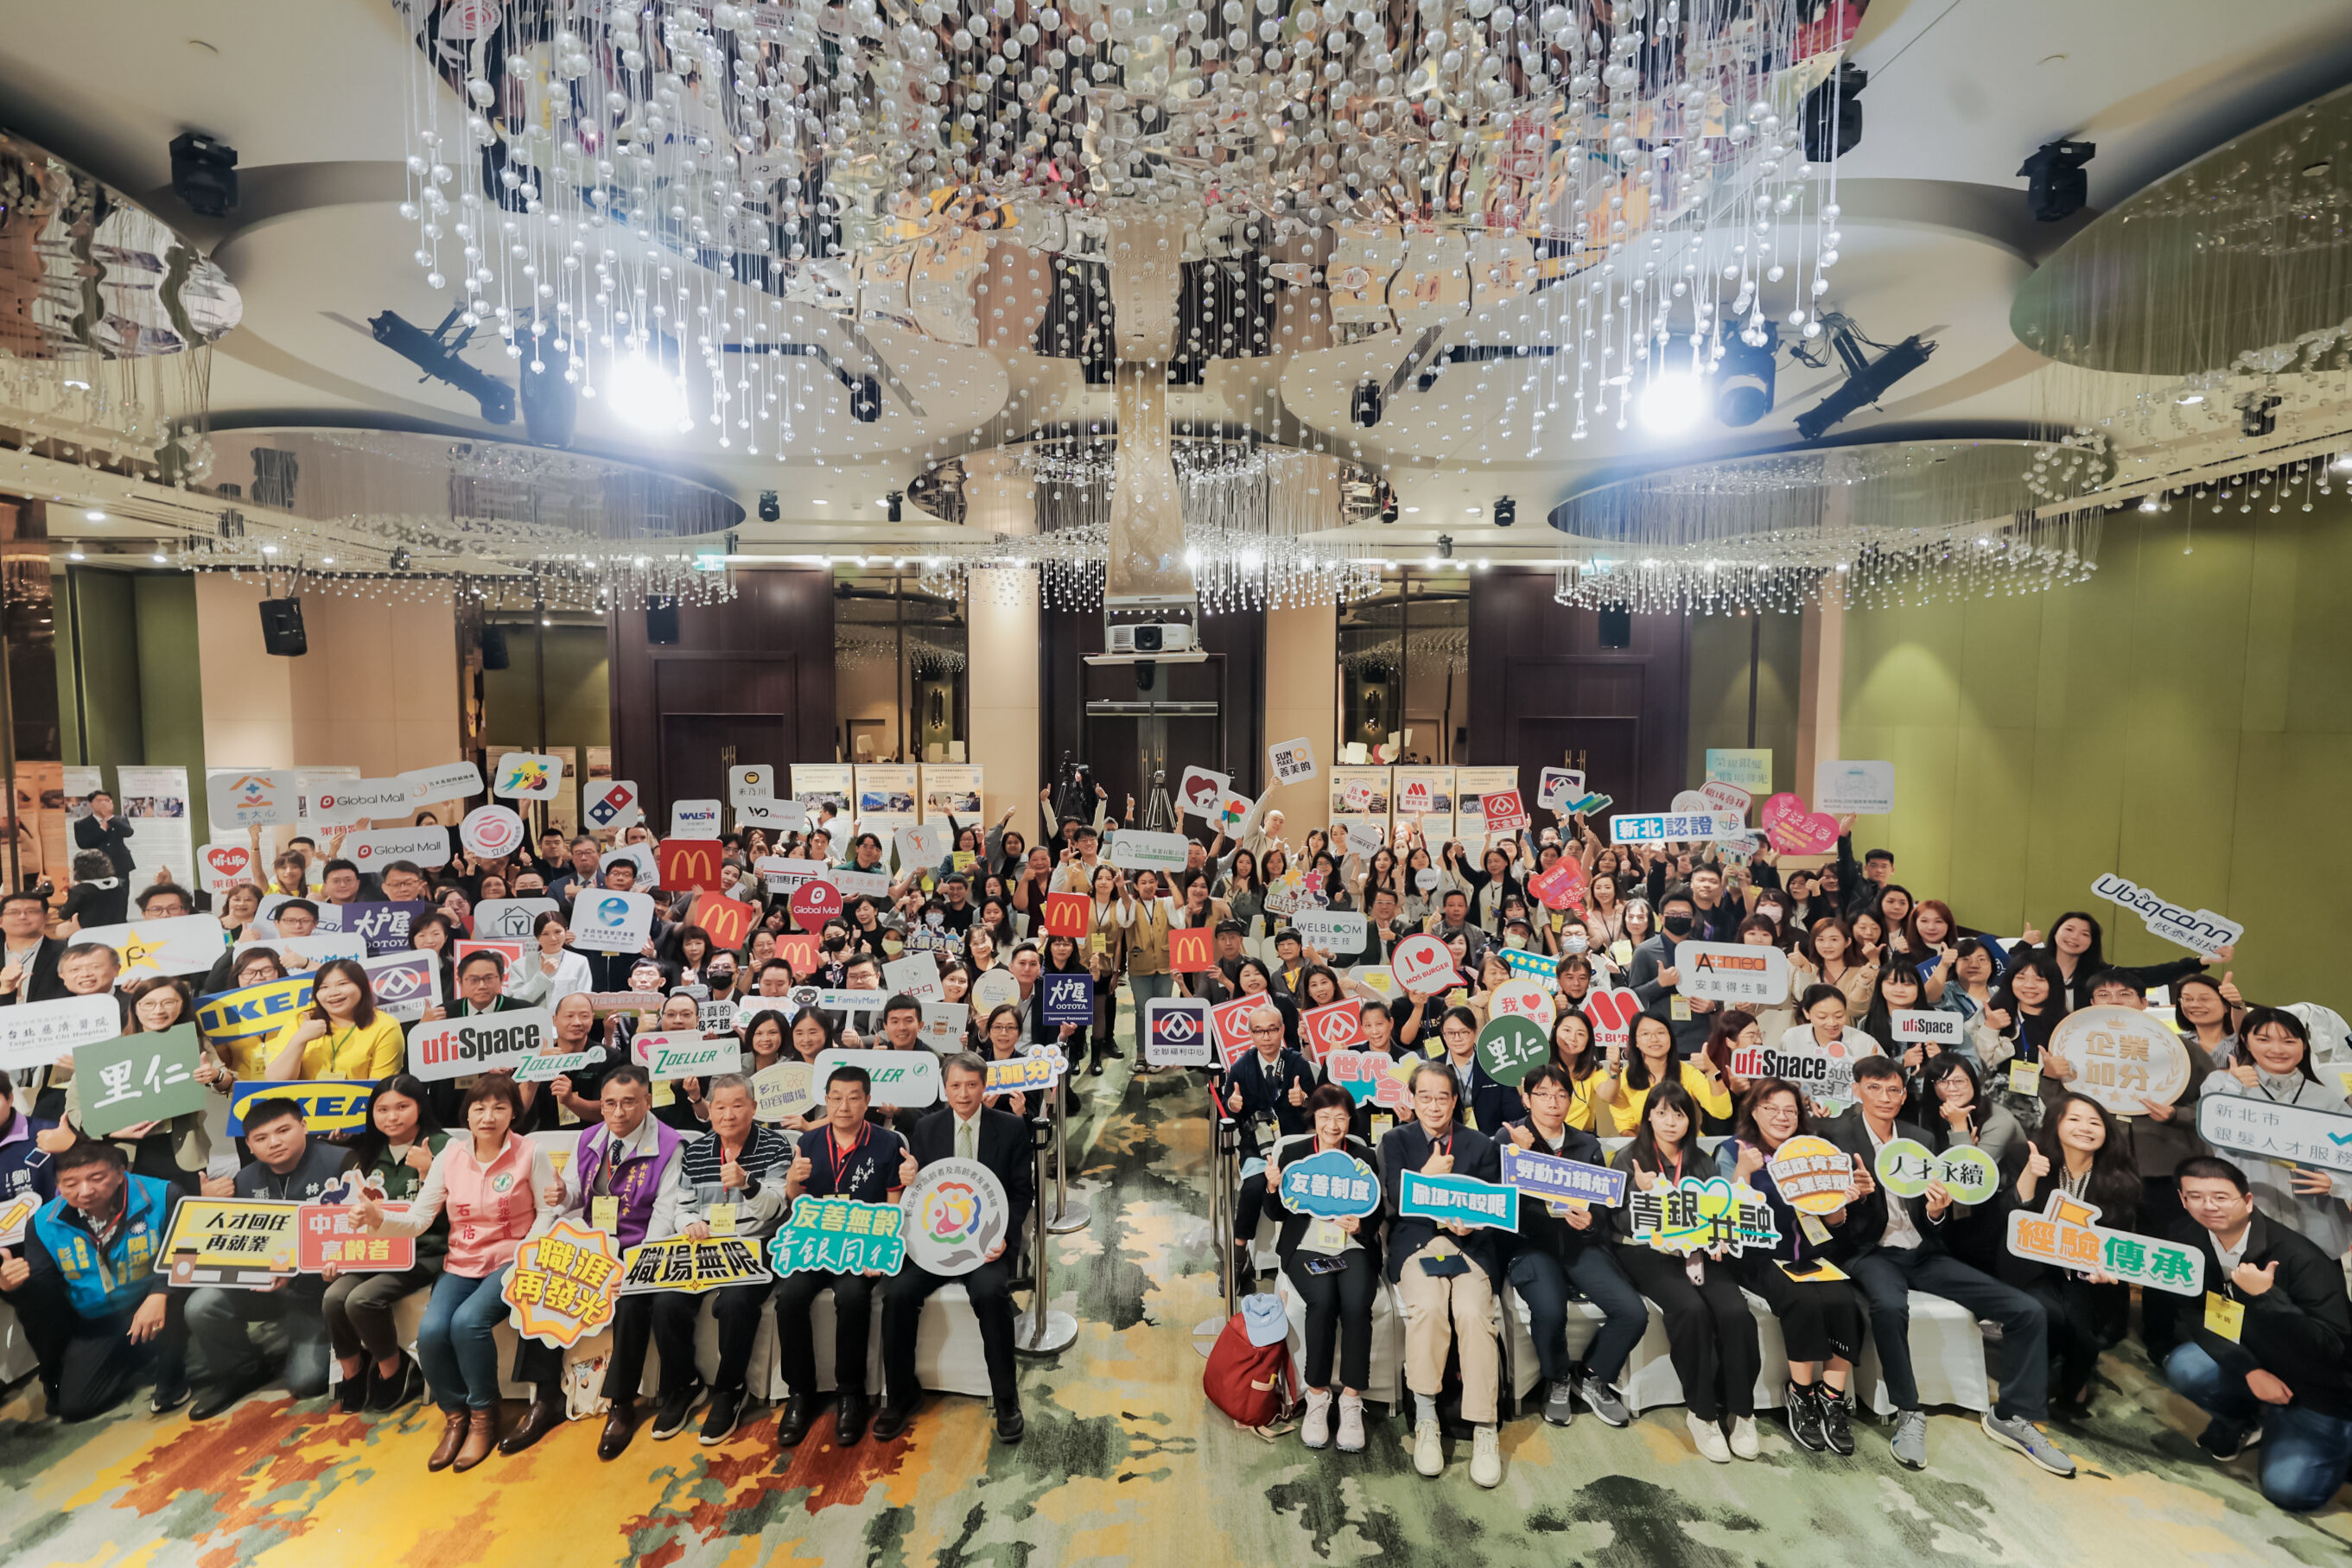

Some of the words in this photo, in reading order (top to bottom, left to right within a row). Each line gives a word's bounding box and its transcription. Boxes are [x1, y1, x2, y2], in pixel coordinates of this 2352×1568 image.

[1275, 750, 1293, 761] SUN
[1277, 759, 1294, 767] MAKE
[1280, 761, 1311, 778] 善美的
[337, 794, 377, 807] Global
[381, 792, 404, 803] Mall
[1350, 786, 1359, 796] 我
[374, 842, 414, 855] Global
[417, 841, 442, 853] Mall
[793, 905, 821, 915] Global
[823, 905, 840, 915] Mall
[1297, 922, 1362, 935] WELBLOOM
[1405, 973, 1422, 986] MOS
[1422, 962, 1450, 980] BURGER
[200, 985, 315, 1031] IKEA
[837, 996, 880, 1006] FamilyMart
[1502, 996, 1519, 1014] 我
[1903, 1017, 1954, 1035] ufiSpace
[422, 1023, 540, 1065] ufiSpace
[1152, 1047, 1205, 1057] 全聯福利中心
[1486, 1031, 1544, 1075] 里仁
[2085, 1031, 2150, 1063] 企業
[517, 1054, 584, 1080] ZOELLER
[654, 1050, 719, 1075] ZOELLER
[1332, 1054, 1389, 1082] 世代
[1735, 1049, 1827, 1081] ufiSpace
[2085, 1059, 2150, 1092] 加分
[92, 1054, 191, 1109] 里仁
[759, 1082, 783, 1095] 多元
[759, 1089, 807, 1110] 包容職場
[2215, 1103, 2280, 1127] 新北市
[2214, 1126, 2352, 1166] 銀髮人才服務
[1515, 1158, 1611, 1197] 勞動力續航
[1889, 1158, 1986, 1187] 人才永續
[1290, 1172, 1370, 1203] 友善制度
[1411, 1181, 1508, 1219] 職場不設限
[206, 1211, 290, 1233] 人才回任
[795, 1201, 901, 1238] 友善無齡
[1631, 1190, 1775, 1254] 青銀共融
[206, 1233, 270, 1254] 再就業
[321, 1239, 390, 1262] 高齡者
[773, 1230, 903, 1270] 青銀同行
[2016, 1216, 2196, 1284] 經驗傳承
[537, 1236, 617, 1290] 職涯
[626, 1241, 767, 1286] 職場無限
[513, 1268, 610, 1327] 再發光
